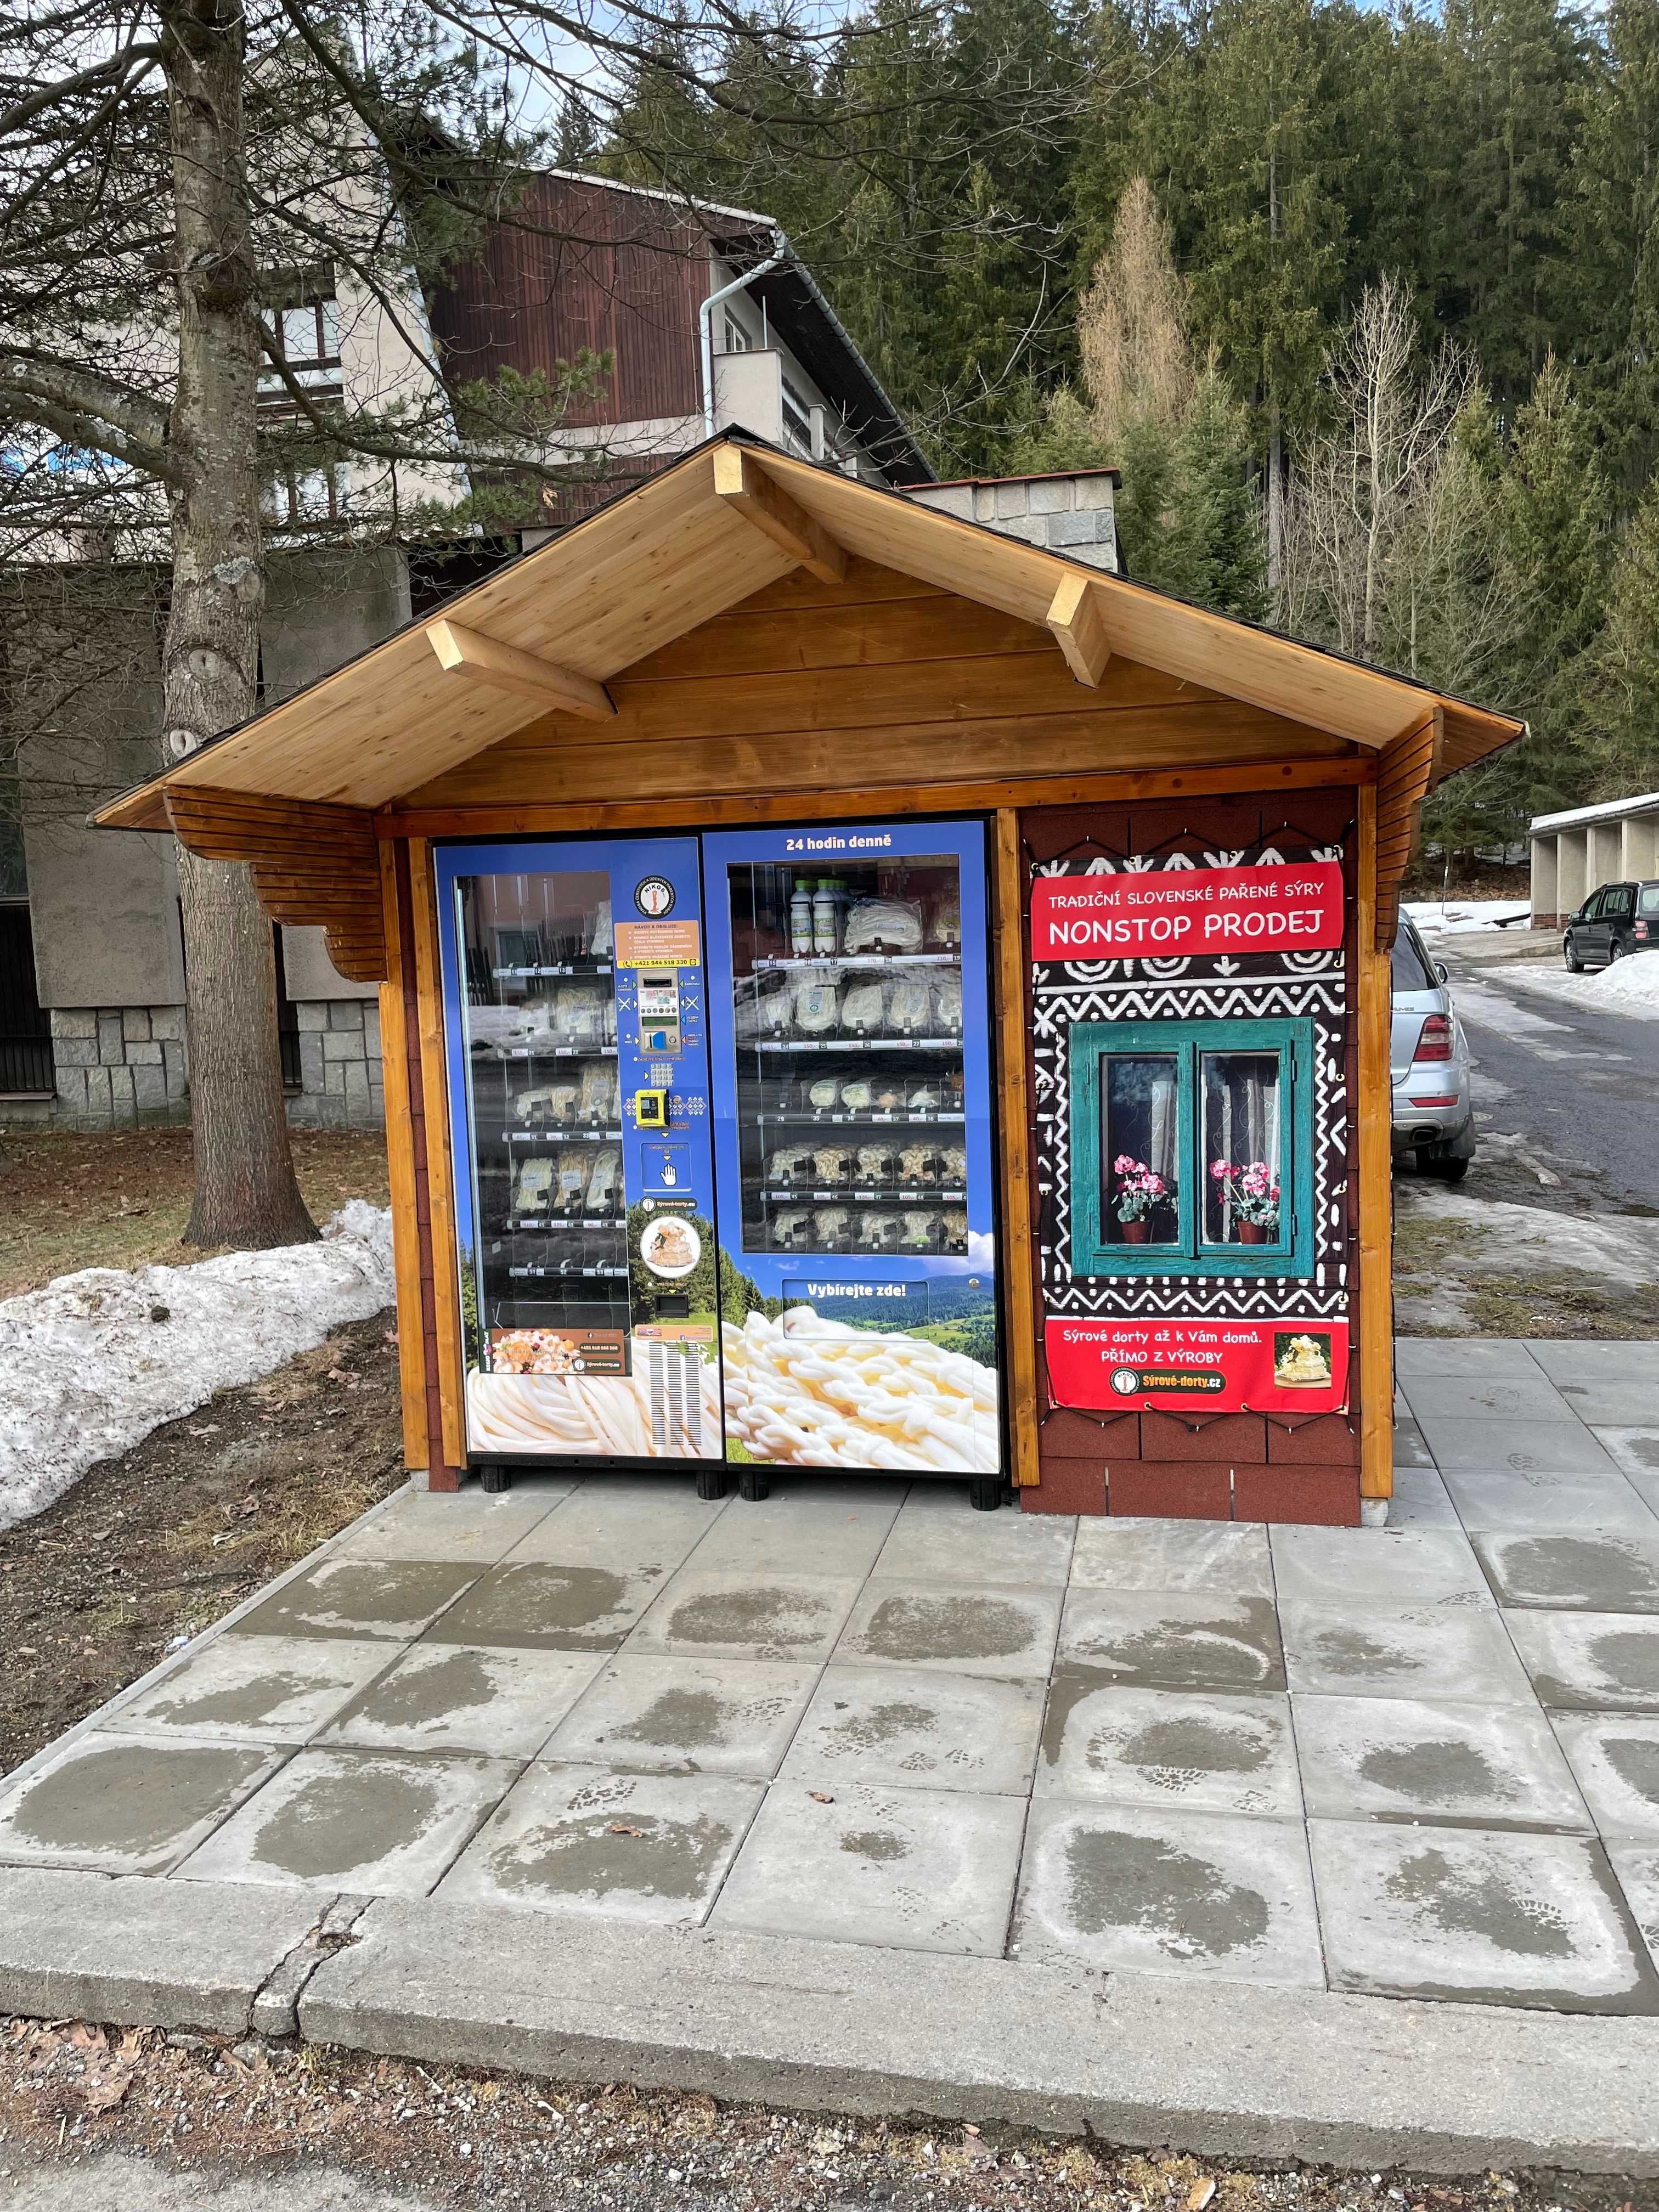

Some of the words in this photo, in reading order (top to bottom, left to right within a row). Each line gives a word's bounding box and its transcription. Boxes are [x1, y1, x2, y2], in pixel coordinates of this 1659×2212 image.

[786, 839, 804, 850] 24
[807, 837, 845, 849] hodin
[849, 834, 891, 848] denně
[645, 884, 665, 893] NIKOS
[1049, 890, 1121, 909] TRADIČNÍ
[1127, 885, 1214, 905] SLOVENSKÉ
[1220, 882, 1278, 900] PAŘENÉ
[1285, 879, 1324, 897] SÝRY
[1049, 915, 1191, 945] NONSTOP
[1204, 909, 1324, 939] PRODEJ
[807, 1284, 873, 1299] Vybírejte
[876, 1284, 906, 1296] zde!
[1063, 1330, 1108, 1343] Sýrové
[1112, 1330, 1149, 1344] dorty
[1154, 1330, 1170, 1342] až
[1176, 1330, 1184, 1342] k
[1188, 1330, 1217, 1343] Vám
[1222, 1330, 1262, 1344] domů.
[1101, 1349, 1148, 1363] PŘÍMO
[1167, 1348, 1223, 1363] VÝROBY
[1143, 1374, 1221, 1389] Sýrové-dorty.cz
